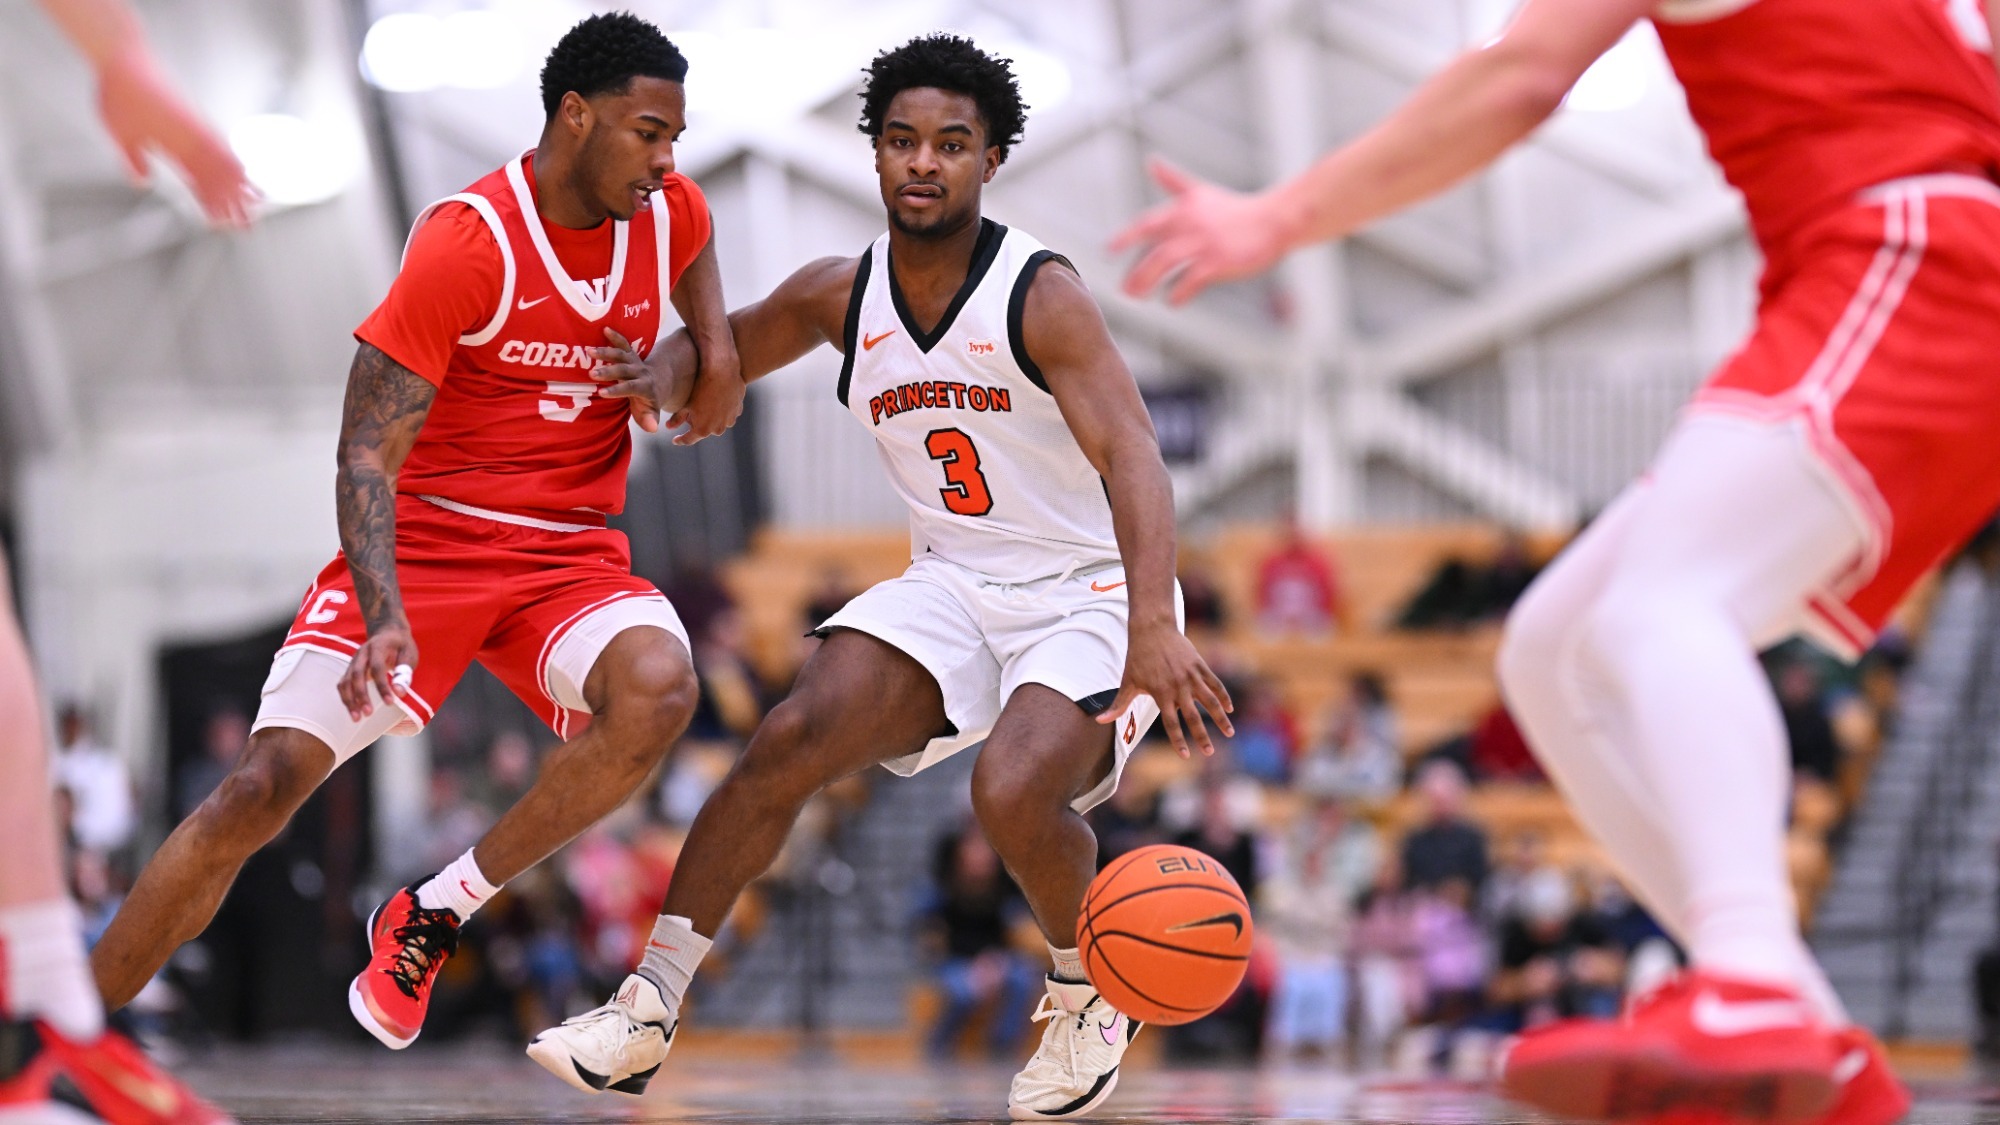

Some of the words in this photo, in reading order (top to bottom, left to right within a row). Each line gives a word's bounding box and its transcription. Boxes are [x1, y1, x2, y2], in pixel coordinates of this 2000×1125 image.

[624, 304, 641, 318] Ivy
[969, 342, 985, 354] Ivy
[869, 381, 1012, 426] PRINCETON
[924, 427, 994, 516] 3
[305, 589, 349, 624] C
